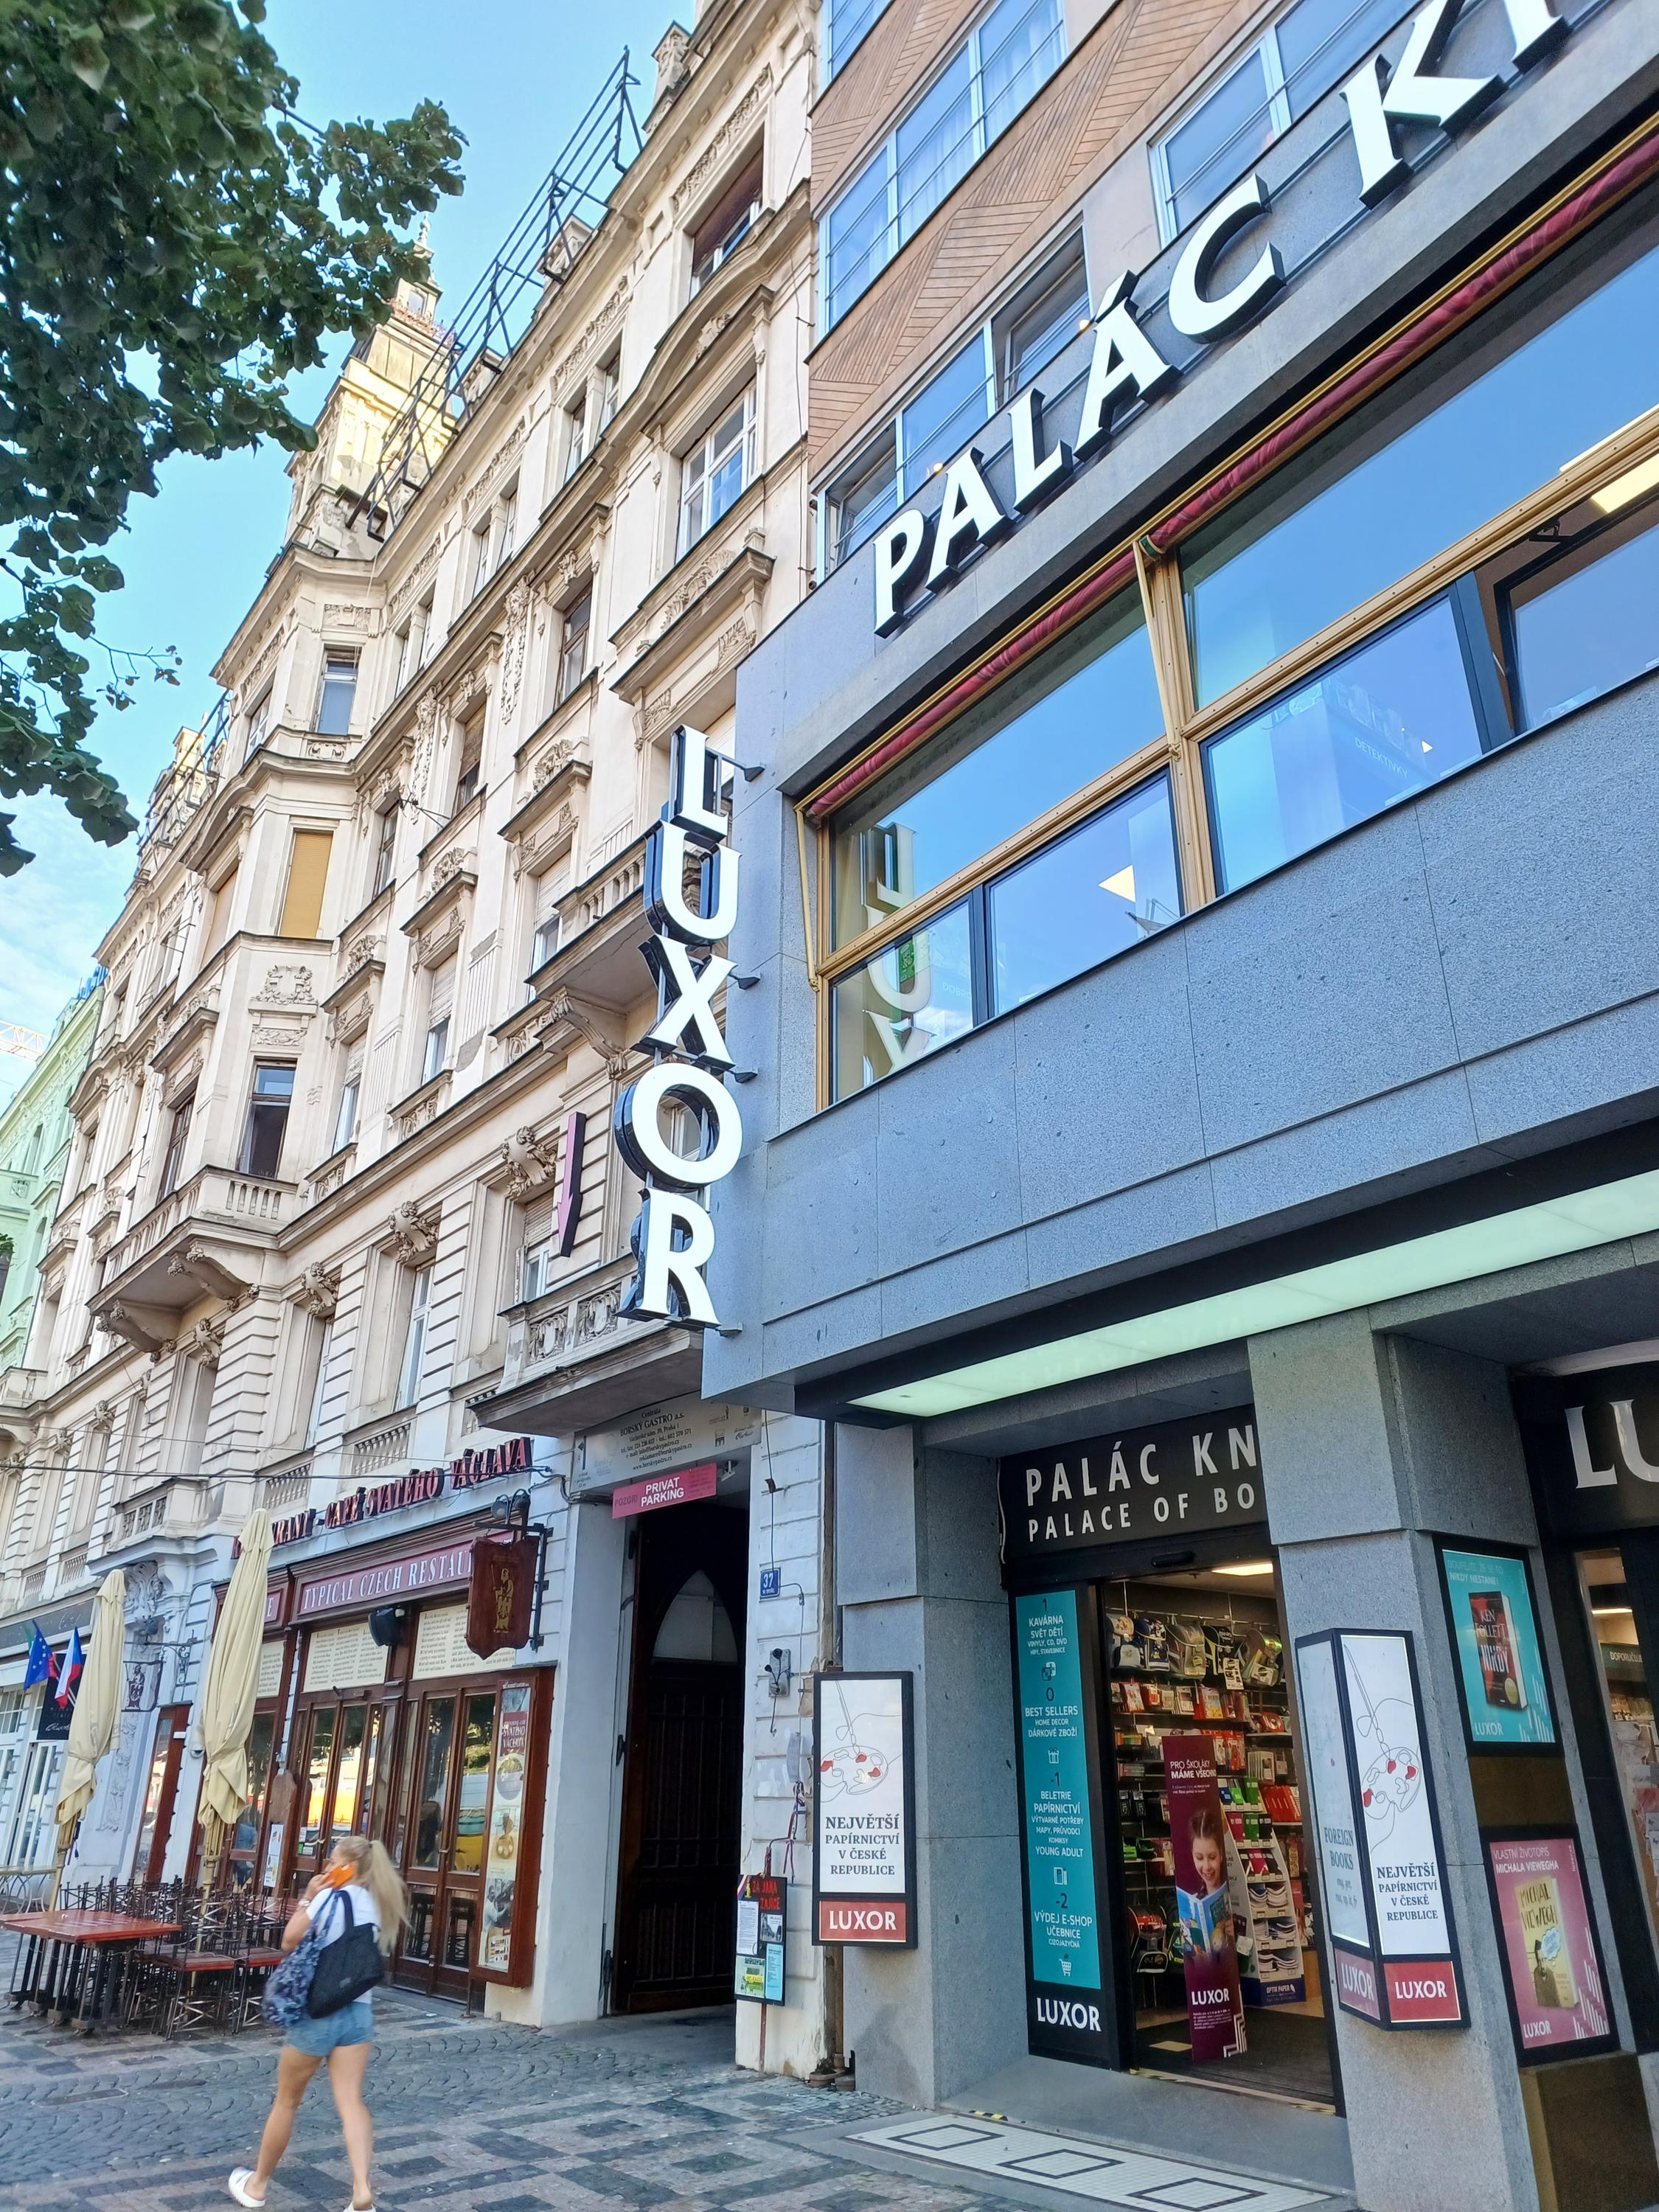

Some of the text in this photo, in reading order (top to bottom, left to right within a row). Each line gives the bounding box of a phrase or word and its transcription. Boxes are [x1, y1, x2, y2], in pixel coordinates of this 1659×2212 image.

[873, 174, 1285, 636] PALÁC
[1354, 737, 1410, 779] DETEKTIVKY
[624, 723, 742, 1326] LUXOR
[644, 1413, 672, 1430] GASTRO
[674, 1412, 684, 1420] a.s.
[1026, 1425, 1257, 1506] PALÁC KN
[325, 1486, 367, 1529] CAFÉ
[366, 1468, 443, 1516] SVATÉHO
[450, 1437, 532, 1489] VÁCLAVA
[646, 1477, 680, 1495] PRIVAT
[641, 1487, 684, 1507] PARKING
[1029, 1483, 1254, 1543] PALACE OF BO
[304, 1578, 354, 1610] TYPICAL
[360, 1566, 401, 1596] CZECH
[763, 1573, 773, 1588] 37
[1042, 1598, 1047, 1612] 1
[1029, 1614, 1064, 1627] KAVÁRNA
[1481, 1609, 1496, 1622] KEN
[1031, 1626, 1063, 1638] SVĚT DĚTÍ
[1475, 1622, 1506, 1640] FOLLETT
[1027, 1639, 1046, 1648] VINYLY,
[1046, 1638, 1056, 1646] CD,
[1481, 1644, 1510, 1674] NIKDY
[1046, 1687, 1054, 1701] 0
[1025, 1705, 1079, 1717] BEST SELLERS
[1029, 1727, 1077, 1737] DÁRKOVÉ ZBOŽÍ
[1475, 1722, 1504, 1736] LUXOR
[1170, 1759, 1210, 1770] PRO ŠKOLÁKY
[1051, 1771, 1060, 1787] -1
[1171, 1770, 1194, 1779] MÁME
[1040, 1791, 1071, 1800] BELETRIE
[1034, 1801, 1080, 1814] PAPÍRNICTVÍ
[825, 1814, 900, 1829] NEJVĚTŠÍ
[1032, 1815, 1084, 1825] VÝTVARNÉ POTŘEBY
[1036, 1826, 1080, 1835] MAPY, PRŮVODCI
[1324, 1827, 1354, 1846] FOREIGN
[825, 1832, 900, 1845] PAPÍRNICTVÍ
[838, 1848, 886, 1860] V ČESKÉ
[1035, 1846, 1084, 1857] YOUNG ADULT
[1493, 1846, 1550, 1860] VLASTNÍ ŽIVOTOPIS
[1329, 1850, 1354, 1871] BOOKS
[1496, 1860, 1559, 1874] MICHALA VIEWEGHA
[830, 1865, 895, 1875] REPUBLICE
[1376, 1862, 1436, 1879] NEJVĚTŠÍ
[1379, 1879, 1438, 1893] PAPÍRNICTVÍ
[1056, 1893, 1068, 1909] -2
[1391, 1894, 1430, 1907] V ČESKÉ
[1520, 1882, 1551, 1908] MICHAL
[830, 1910, 897, 1930] LUXOR
[1034, 1910, 1093, 1927] VÝDEJ E-SHOP
[1387, 1910, 1438, 1921] REPUBLICE
[1046, 1925, 1081, 1939] UČEBNICE
[1048, 1938, 1080, 1948] CIZOJAZYČNÁ
[1340, 1962, 1375, 2001] LUXOR
[1191, 1988, 1230, 2006] LUXOR
[1394, 1980, 1447, 2000] LUXOR
[1037, 1997, 1102, 2032] LUXOR
[1523, 2019, 1552, 2039] LUXOR
